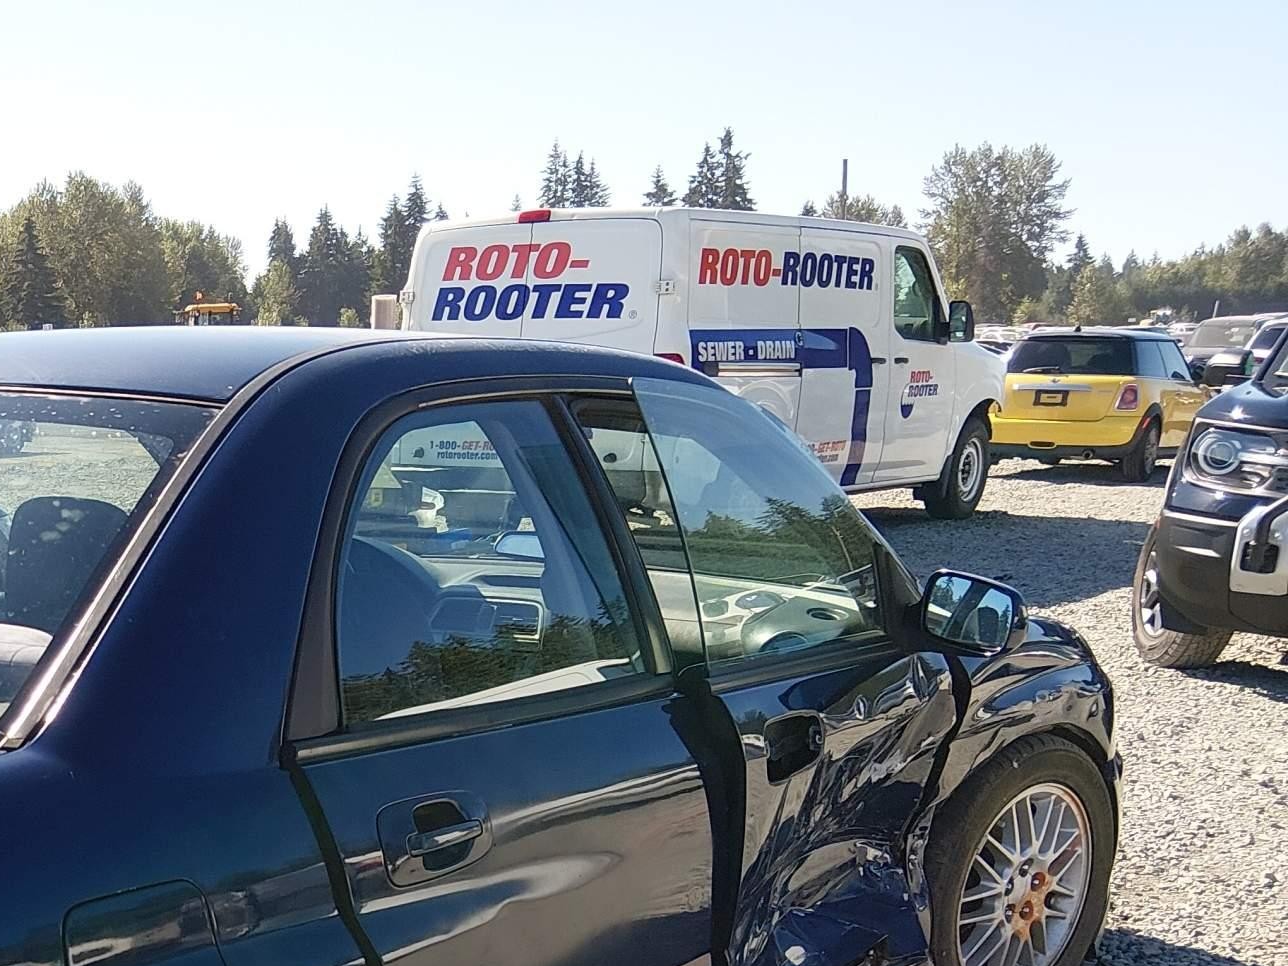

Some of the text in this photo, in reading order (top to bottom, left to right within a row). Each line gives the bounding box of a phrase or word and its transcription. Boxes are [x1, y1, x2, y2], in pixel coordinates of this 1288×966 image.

[442, 241, 590, 282] ROTO-
[698, 248, 875, 291] ROTO-ROOTER
[431, 283, 630, 322] ROOTER
[698, 341, 745, 362] SEWER
[757, 340, 796, 360] DRAIN
[907, 383, 939, 398] ROOTER
[910, 370, 934, 383] ROTO-
